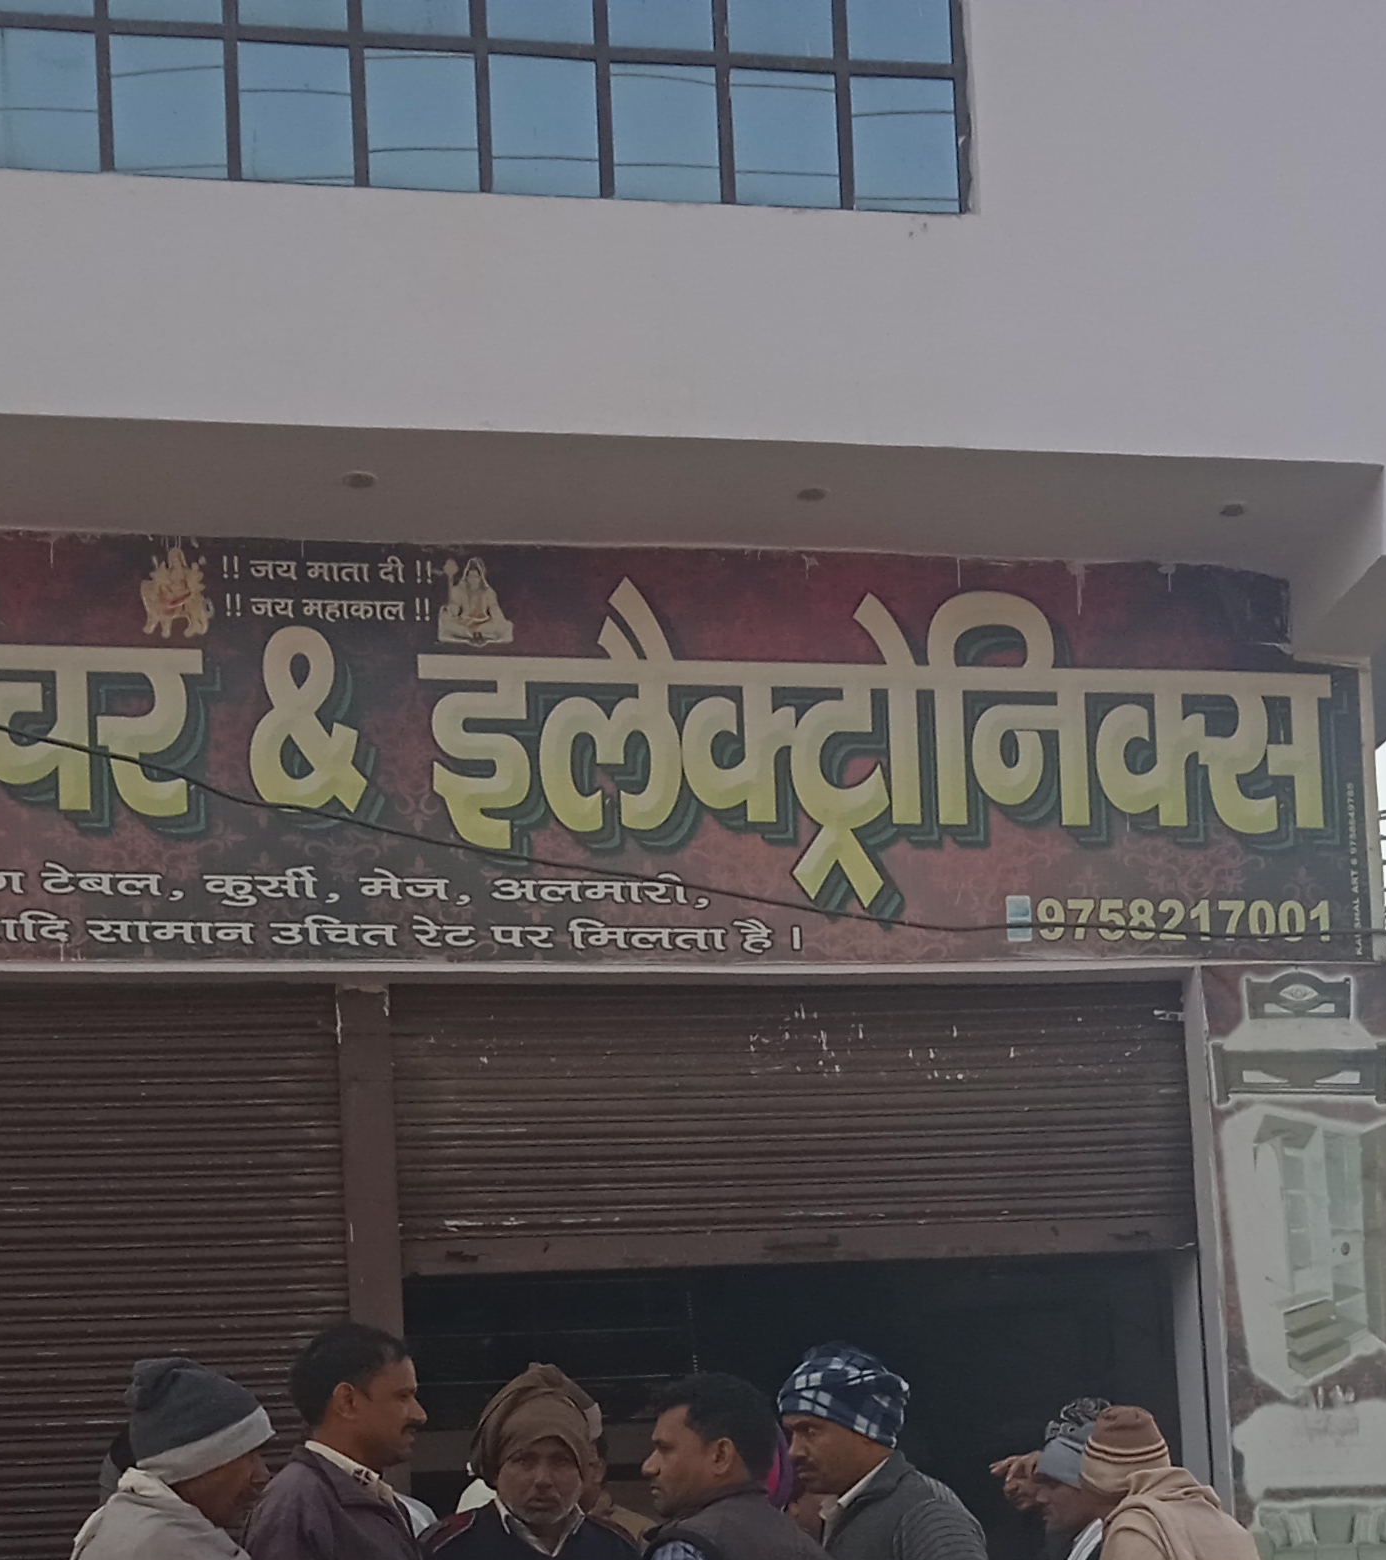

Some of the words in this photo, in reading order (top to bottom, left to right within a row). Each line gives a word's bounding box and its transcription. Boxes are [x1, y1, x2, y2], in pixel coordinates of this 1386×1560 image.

[249, 559, 297, 581] जय
[306, 561, 369, 582] माता
[378, 555, 405, 583] दी
[250, 598, 294, 618] जय
[302, 599, 405, 622] महाकाल
[249, 625, 368, 812] &
[41, 862, 185, 901] टेबल,
[202, 866, 340, 907] कुर्सी,
[359, 868, 471, 905] मेज,
[86, 920, 254, 945] सामान
[270, 914, 398, 946] उचित
[412, 915, 476, 947] रेट
[490, 925, 554, 948] पर
[568, 917, 726, 951] मिलता
[733, 918, 773, 954] है
[1036, 898, 1332, 942] 9758217001
